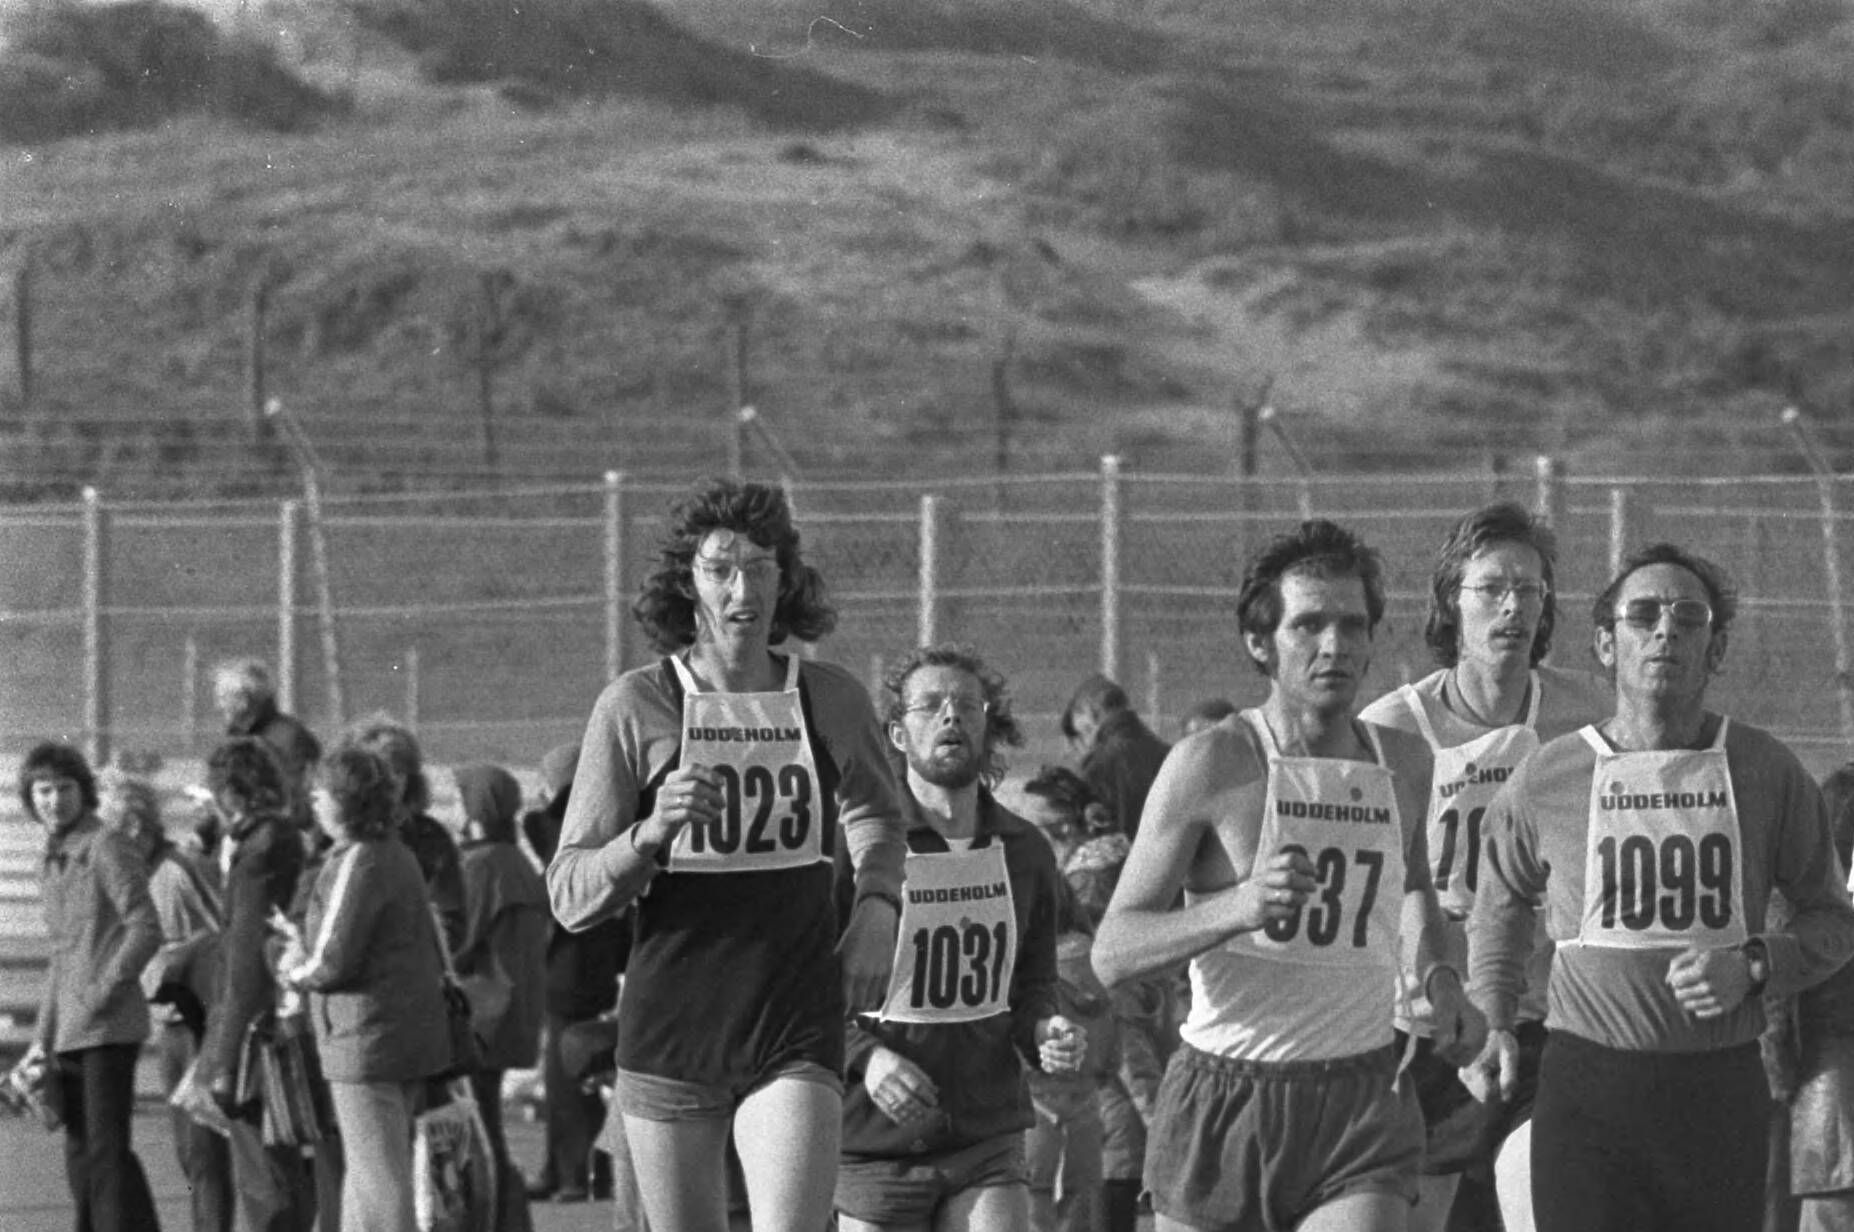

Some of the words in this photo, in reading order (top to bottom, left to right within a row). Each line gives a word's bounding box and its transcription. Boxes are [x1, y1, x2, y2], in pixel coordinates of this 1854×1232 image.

[688, 727, 802, 742] UDDEHOLM
[1276, 800, 1391, 825] UDDEHOLM
[1600, 791, 1728, 811] UDDEHOLM
[909, 881, 1007, 904] UDDEHOLM
[1597, 832, 1733, 931] 1099
[910, 920, 1008, 1009] 1031
